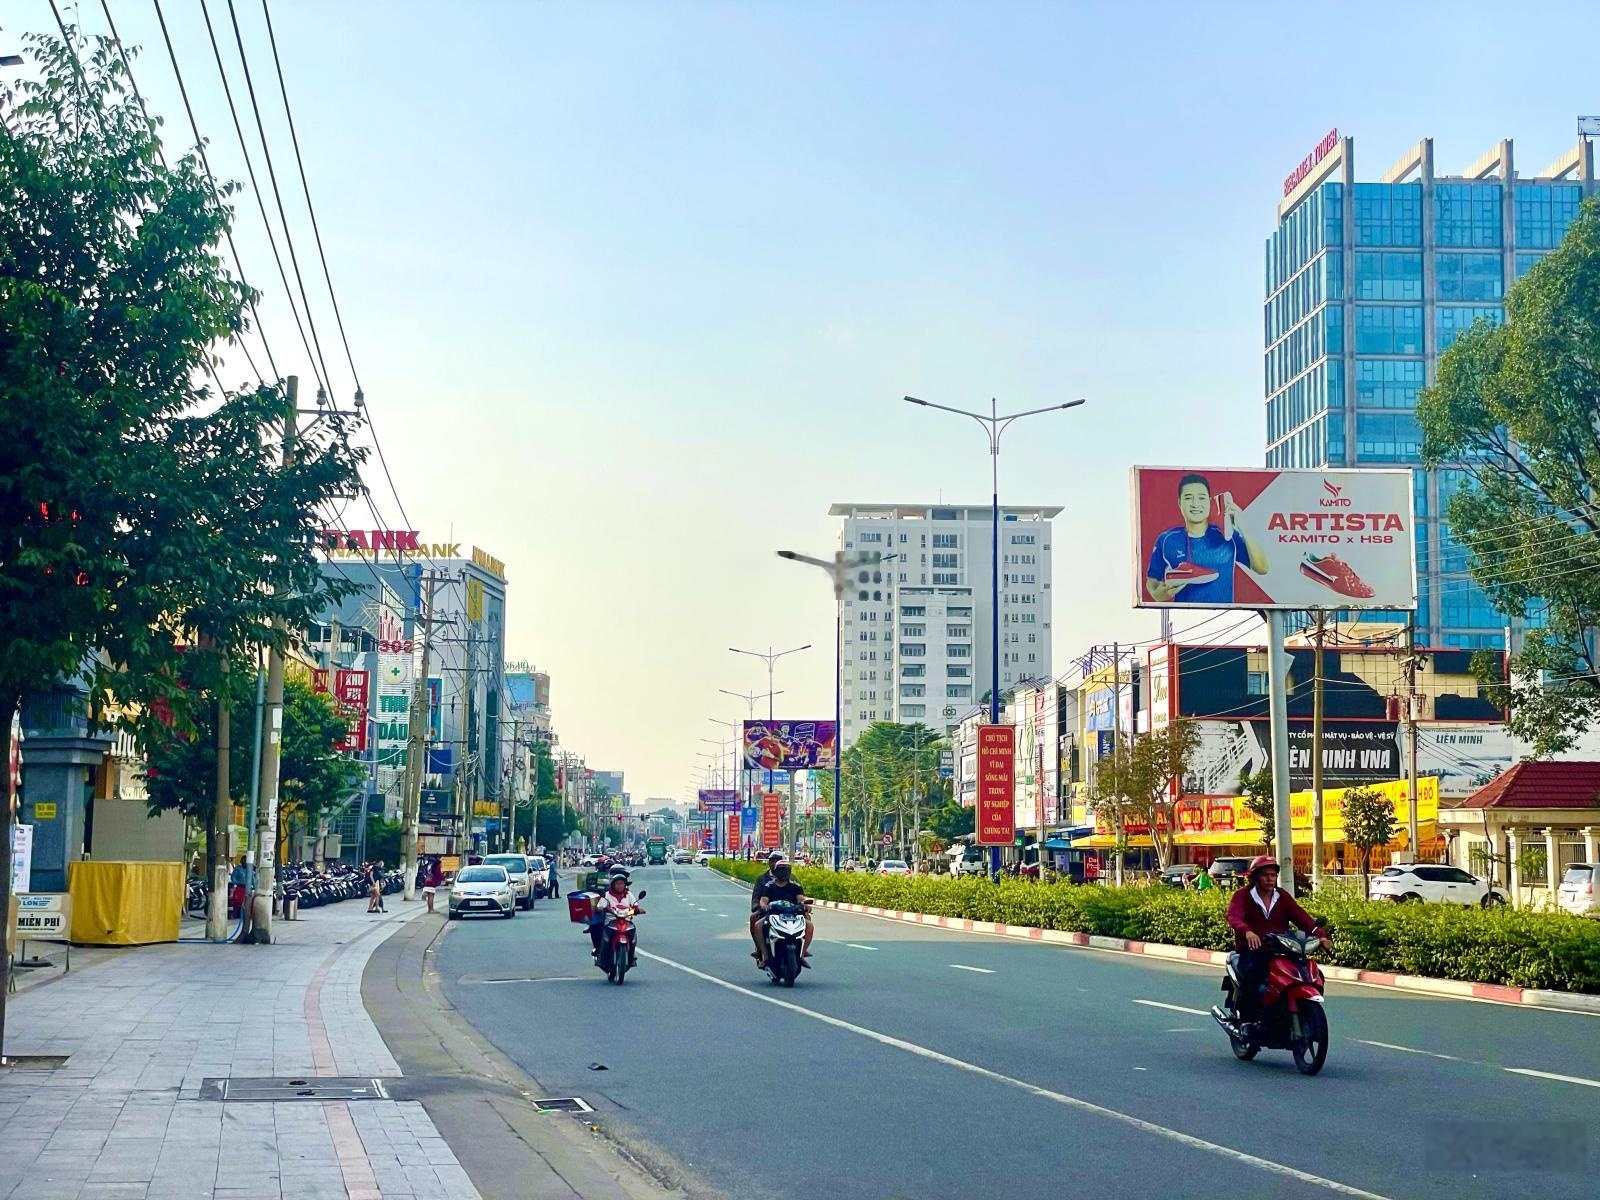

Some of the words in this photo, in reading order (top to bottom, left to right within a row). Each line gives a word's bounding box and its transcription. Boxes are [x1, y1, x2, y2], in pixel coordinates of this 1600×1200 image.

[1314, 127, 1338, 166] TOWER
[1320, 498, 1351, 507] KAMITO
[1268, 512, 1404, 532] ARTISTA
[1279, 534, 1340, 543] KAMITO
[1360, 535, 1393, 543] HS8
[407, 543, 462, 558] BANK
[1298, 729, 1306, 739] CỔ
[1339, 732, 1347, 741] VỤ
[1351, 731, 1364, 739] BẢO
[1458, 735, 1483, 745] MINH
[981, 746, 989, 755] HỒ
[990, 746, 998, 755] CHÍ
[999, 747, 1012, 755] MINH
[1360, 749, 1391, 769] VNA
[988, 787, 1005, 795] TRONG
[44, 915, 60, 927] PHÍ
